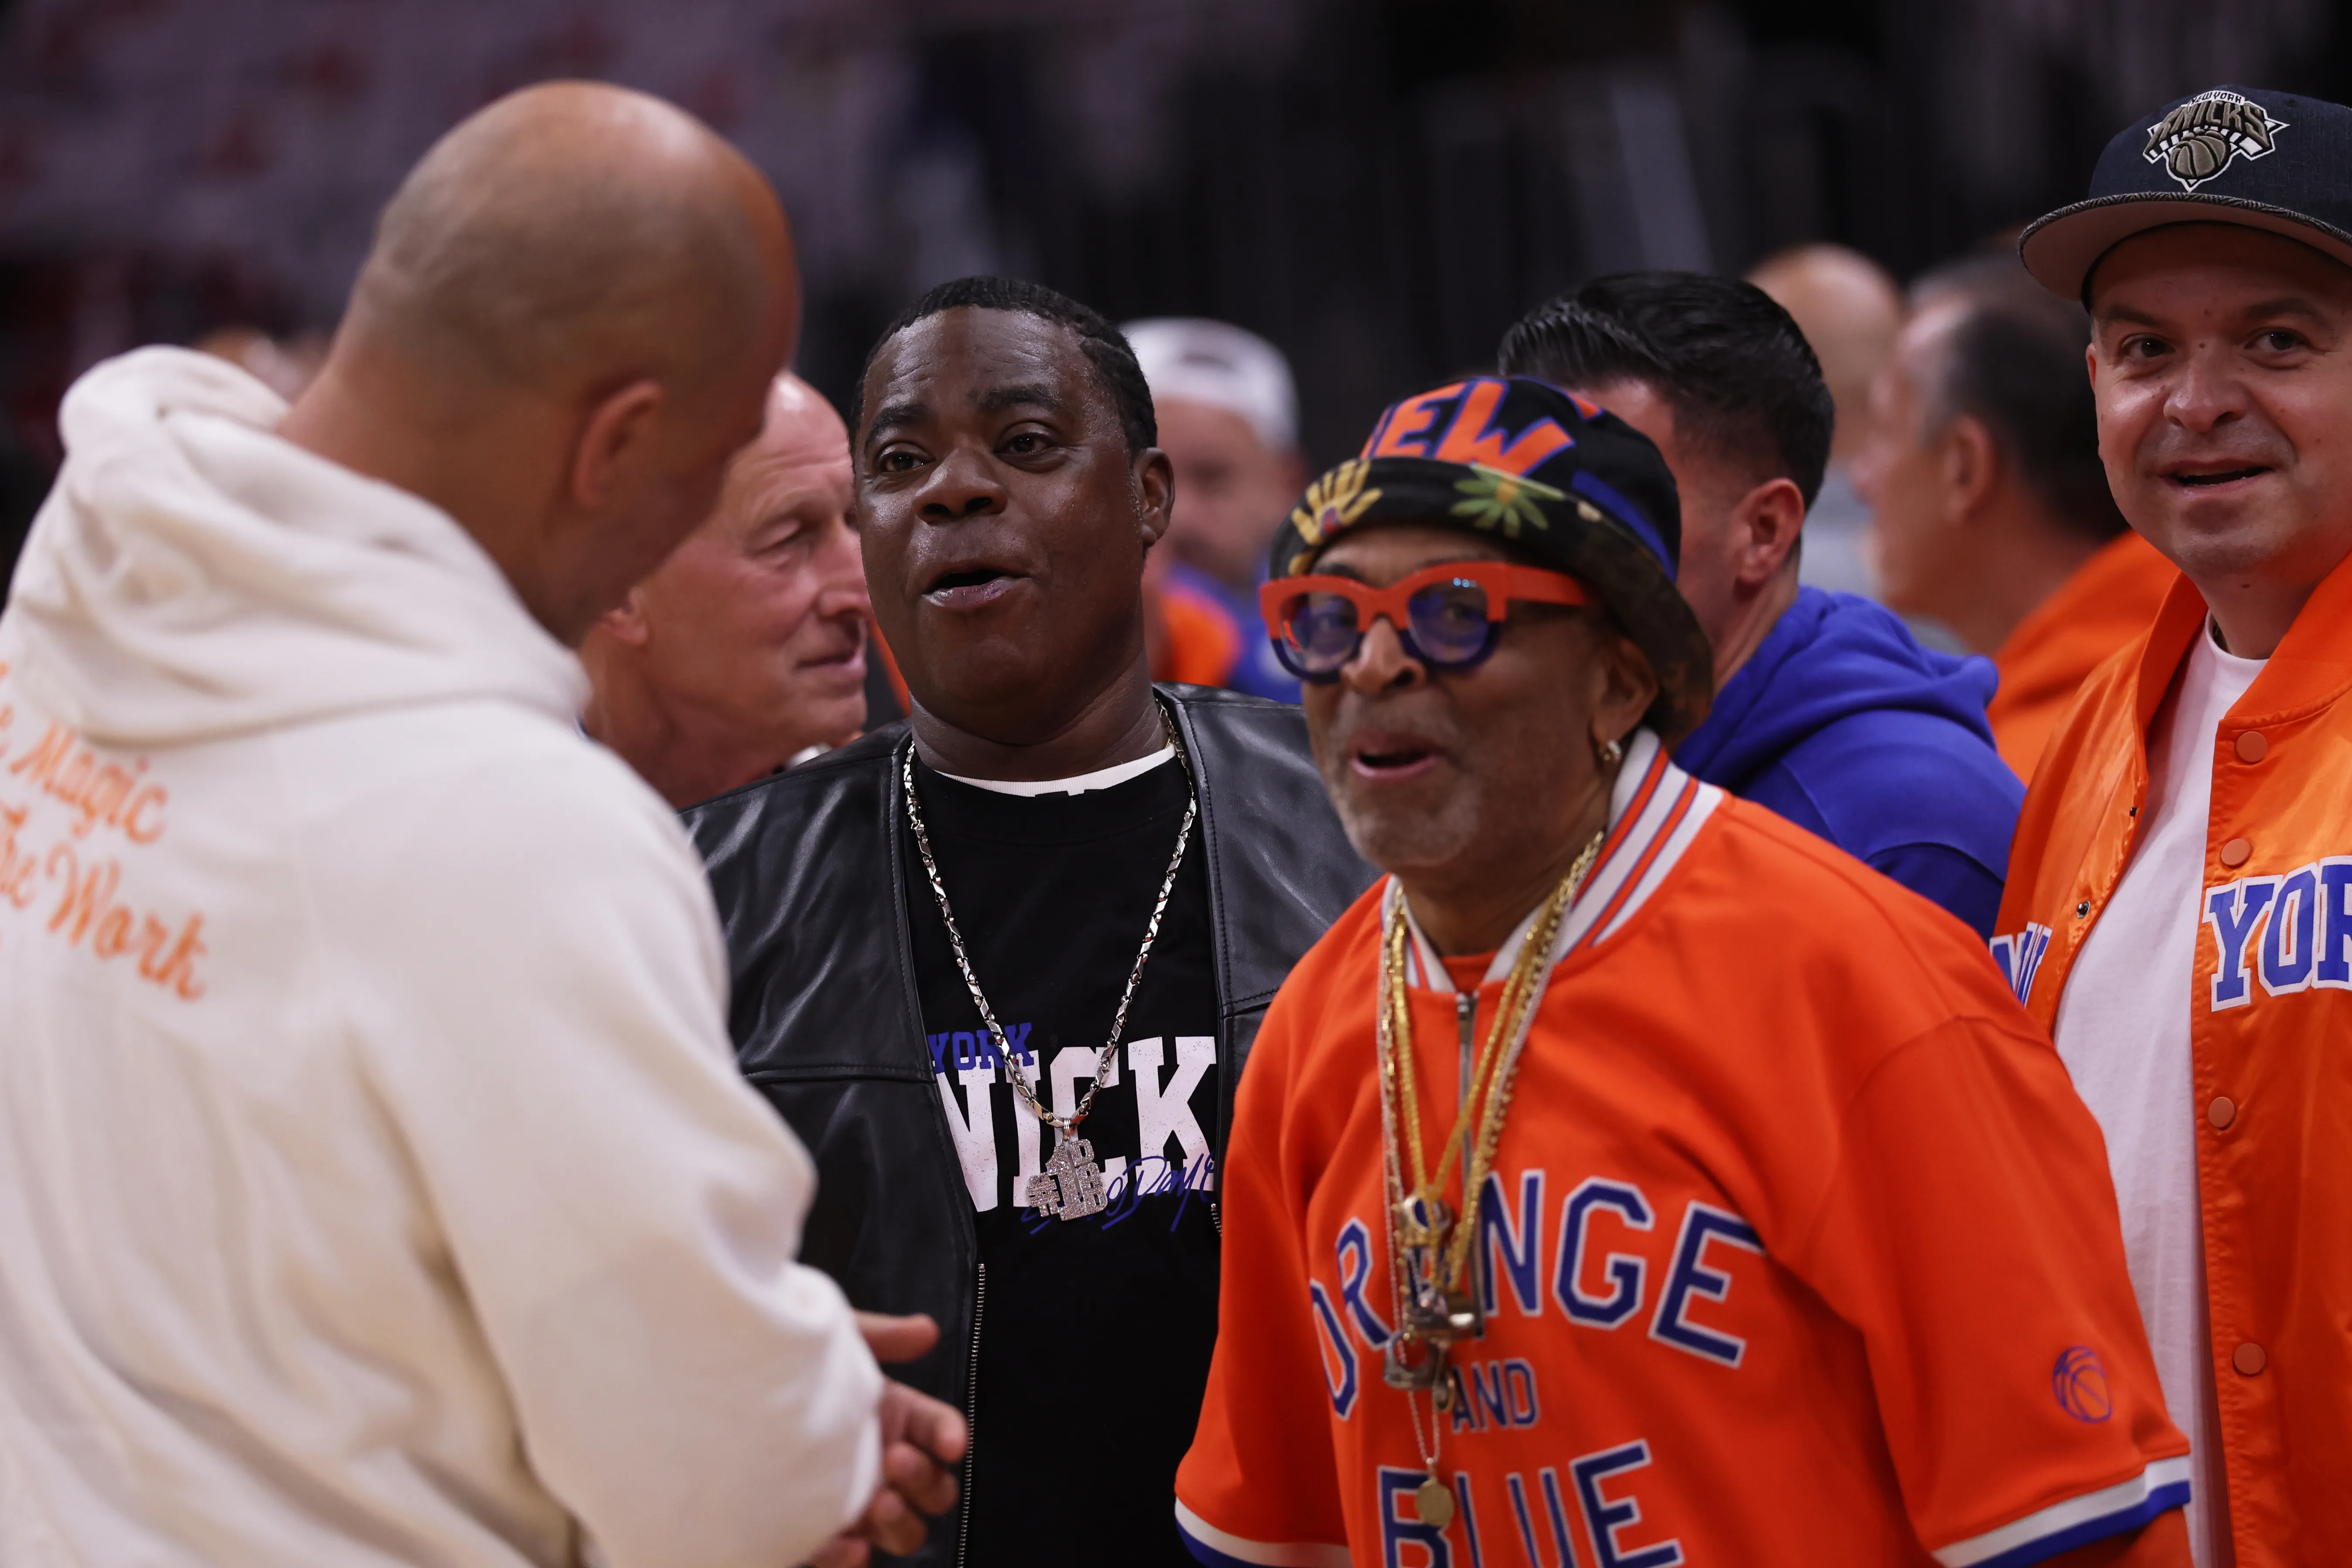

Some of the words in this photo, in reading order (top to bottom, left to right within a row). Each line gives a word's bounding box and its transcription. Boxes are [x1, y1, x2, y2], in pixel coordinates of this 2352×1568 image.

[2144, 100, 2270, 153] KNICKS
[2187, 92, 2212, 106] NEW
[2213, 91, 2242, 104] YORK
[1360, 377, 1576, 478] EW
[10, 720, 168, 844] Magic
[45, 841, 209, 1003] Work
[927, 1022, 1034, 1074] YORK
[1452, 1357, 1538, 1435] AND
